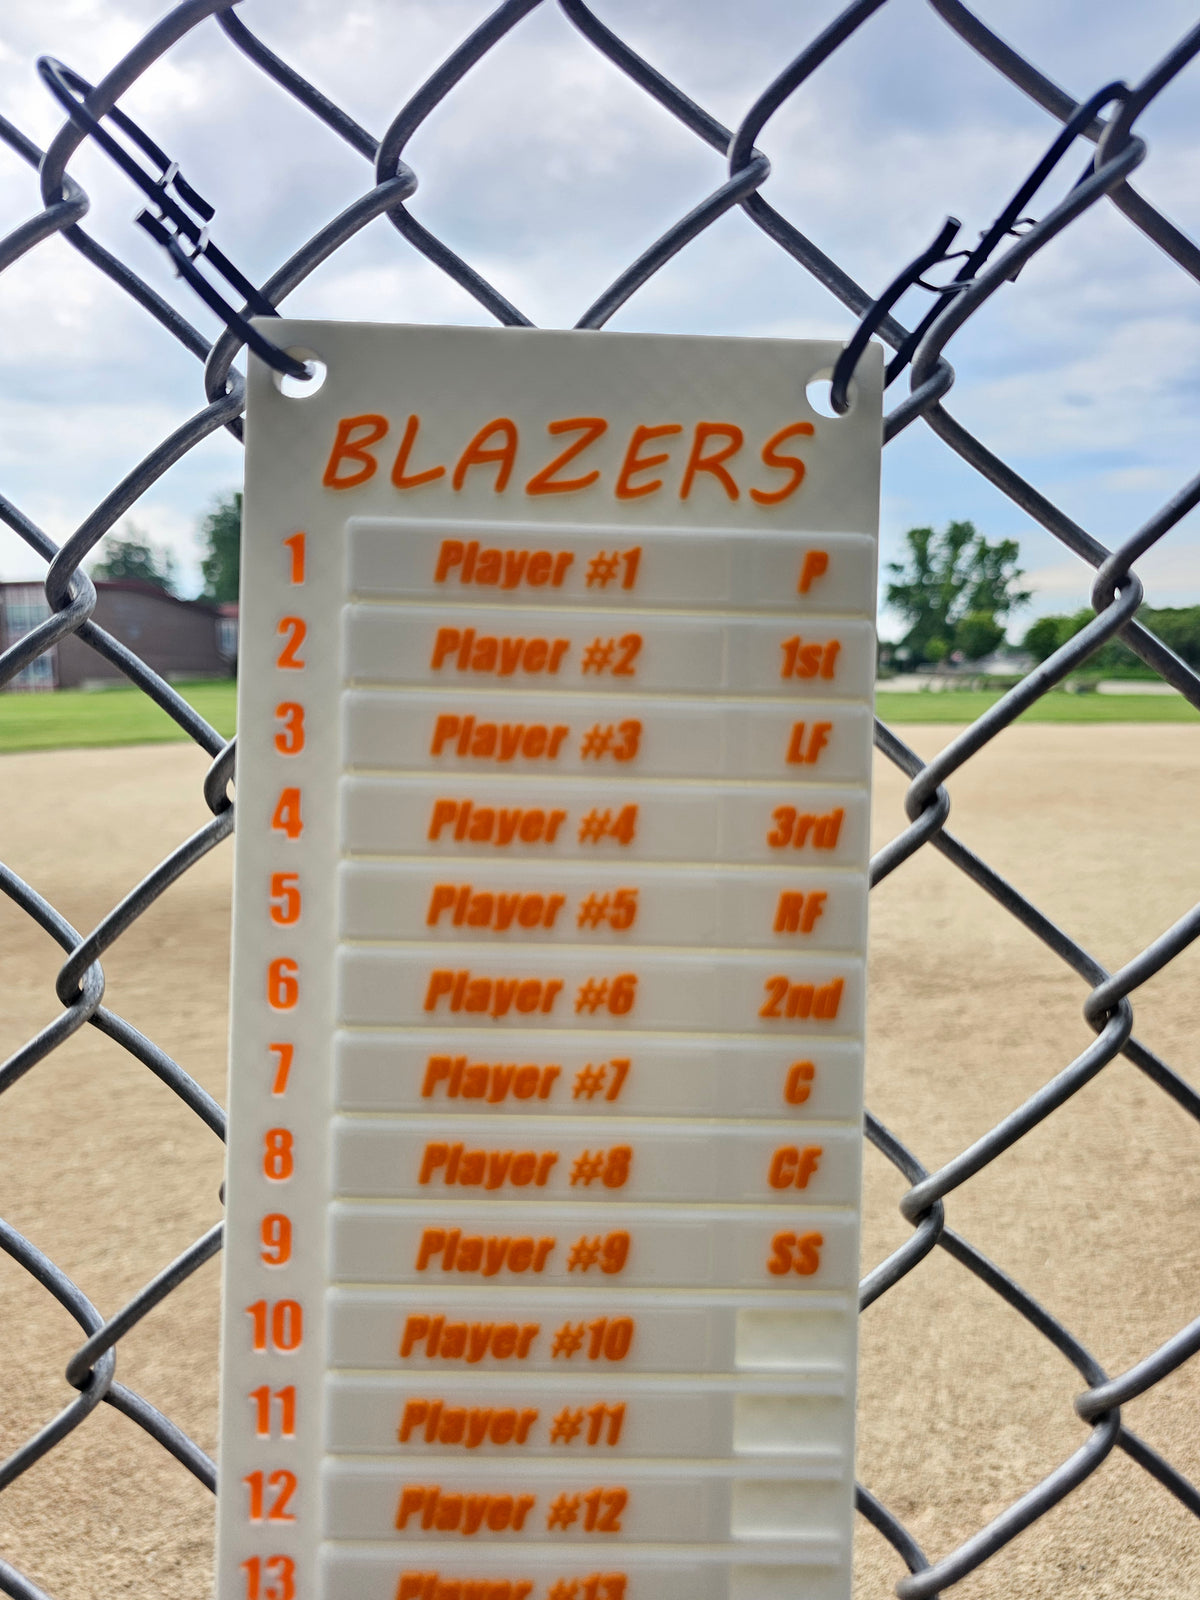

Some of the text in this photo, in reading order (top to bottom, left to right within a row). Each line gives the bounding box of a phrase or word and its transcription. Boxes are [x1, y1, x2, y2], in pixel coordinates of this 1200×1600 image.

[322, 412, 815, 506] BLAZERS
[284, 532, 830, 595] 1 Player #1 P
[276, 616, 842, 681] 2 Player #2 1st
[274, 701, 833, 767] 3 Player #3 LF
[271, 787, 845, 851] 4 Player #4 3rd
[269, 872, 828, 935] 5 Player #5 RF
[267, 957, 846, 1022] 6 Player #6 2nd
[269, 1043, 816, 1107] 7 Player #7 C
[263, 1127, 823, 1192] 8 Player #8 CF
[260, 1213, 824, 1278] 9 Player #9 SS
[246, 1299, 635, 1365] 10 Player #10
[249, 1385, 627, 1450] 11 Player #11
[244, 1469, 630, 1537] 12 Player #12
[241, 1555, 296, 1600] 13
